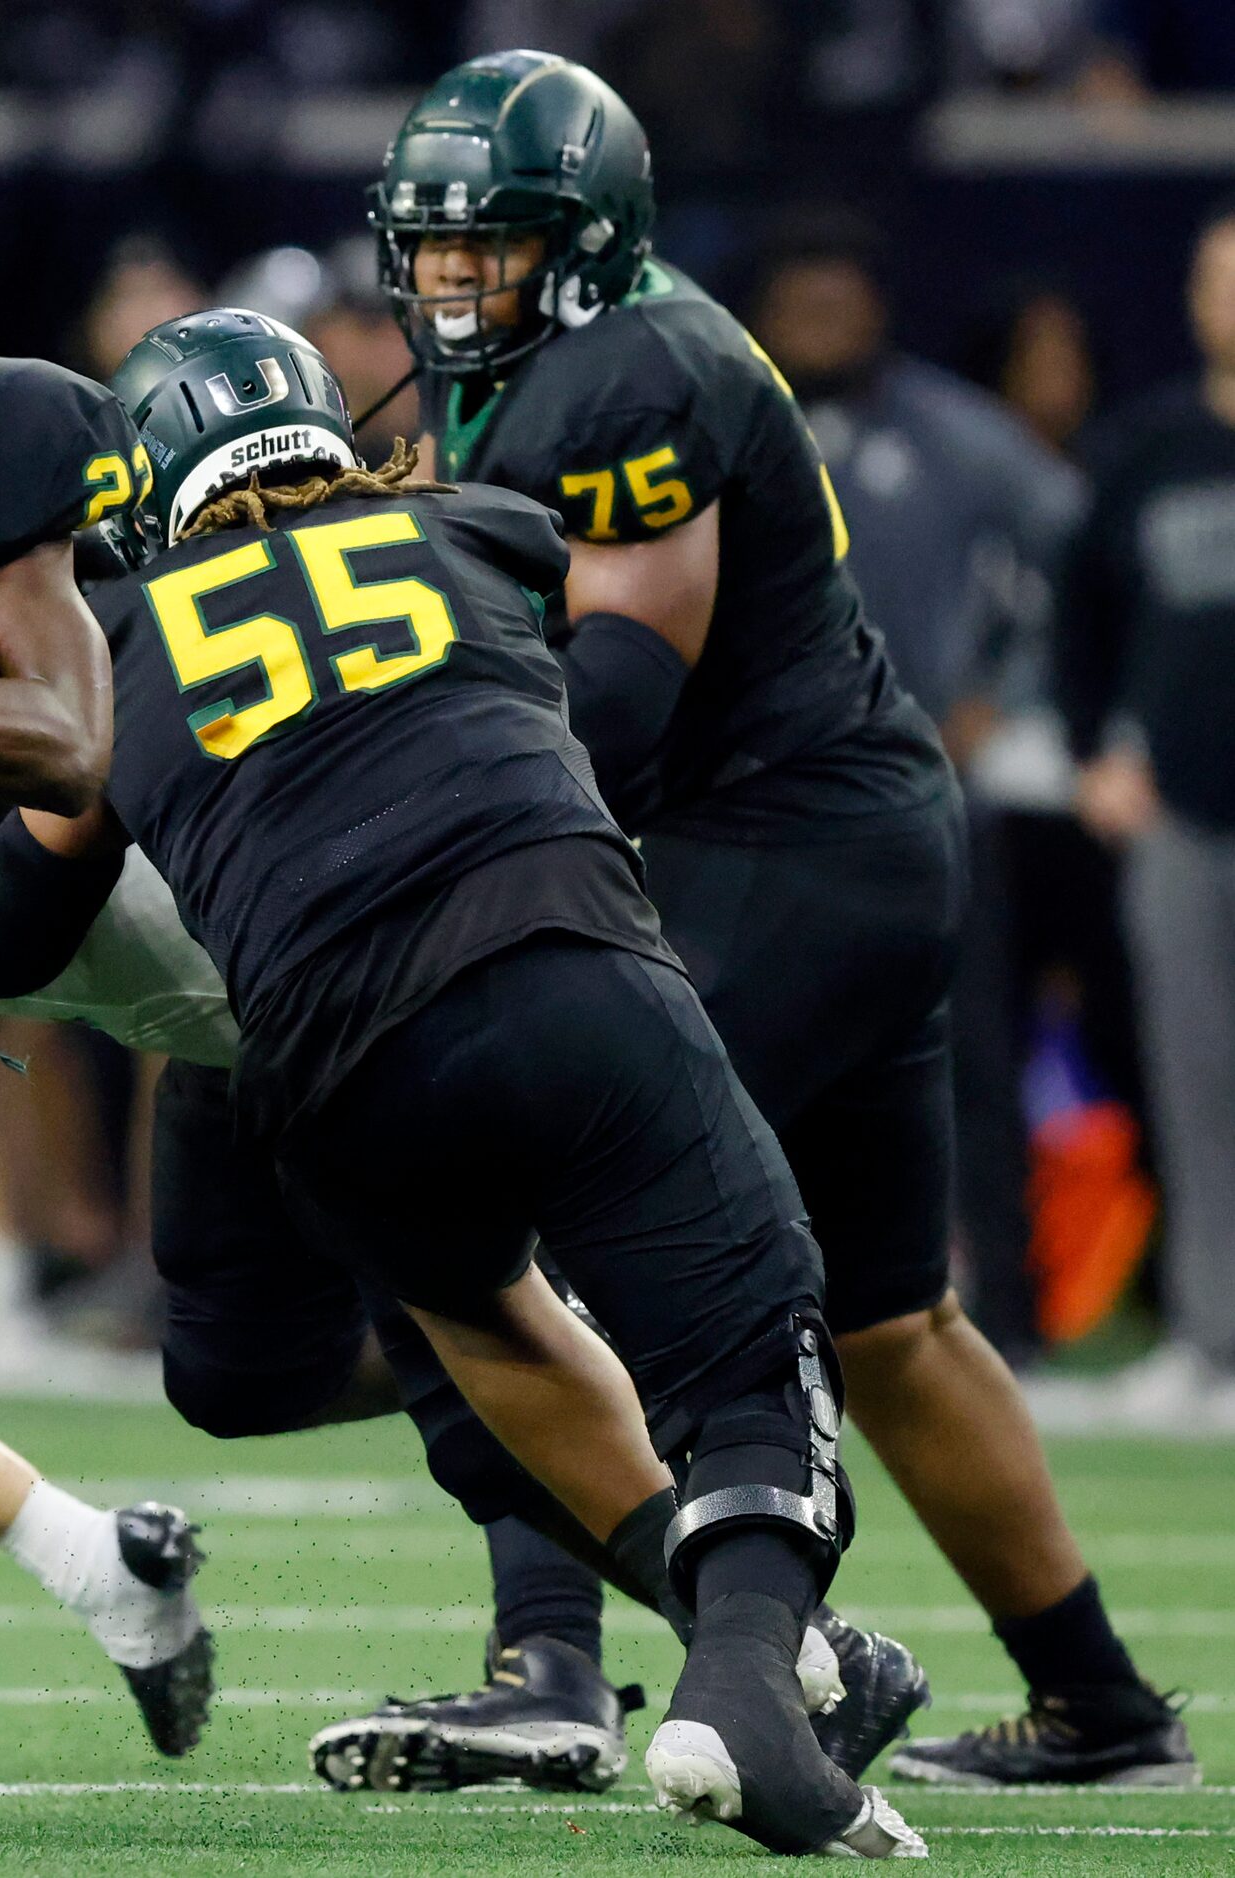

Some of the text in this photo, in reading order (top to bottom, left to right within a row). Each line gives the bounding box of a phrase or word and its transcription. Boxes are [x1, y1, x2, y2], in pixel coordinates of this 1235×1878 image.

[230, 428, 313, 469] schutt
[560, 445, 693, 540] 75
[141, 511, 459, 761] 55
